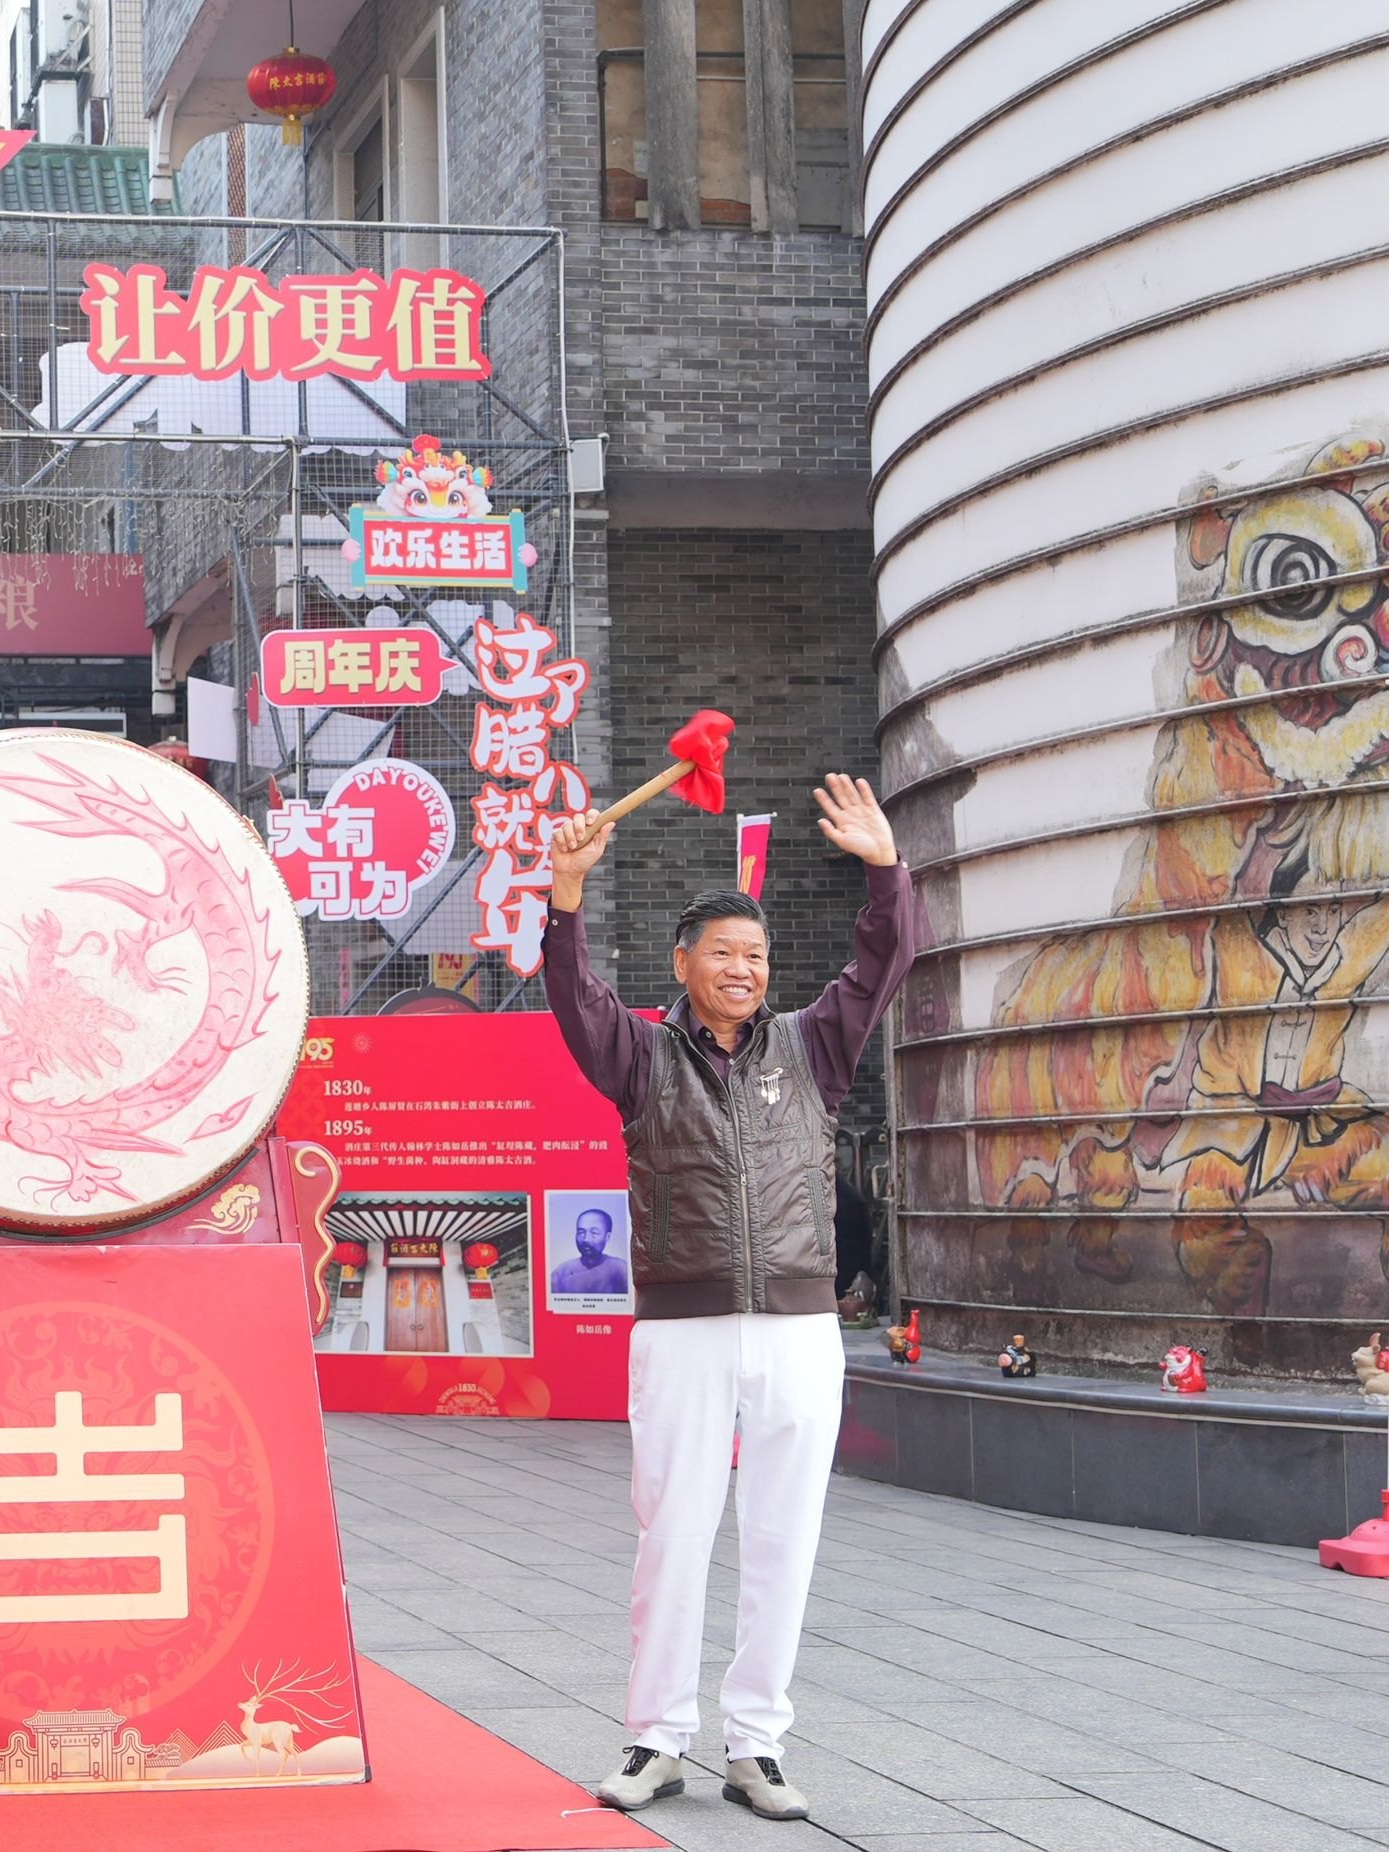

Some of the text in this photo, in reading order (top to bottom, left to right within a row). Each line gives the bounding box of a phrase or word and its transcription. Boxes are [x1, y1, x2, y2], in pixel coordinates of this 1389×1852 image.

[89, 272, 483, 373] 让价更值
[370, 527, 507, 571] 欢乐生活
[279, 638, 422, 696] 周年庆
[271, 802, 376, 858] 大有
[308, 861, 409, 917] 可为
[323, 1080, 372, 1097] 1830年
[324, 1119, 373, 1136] 1895年
